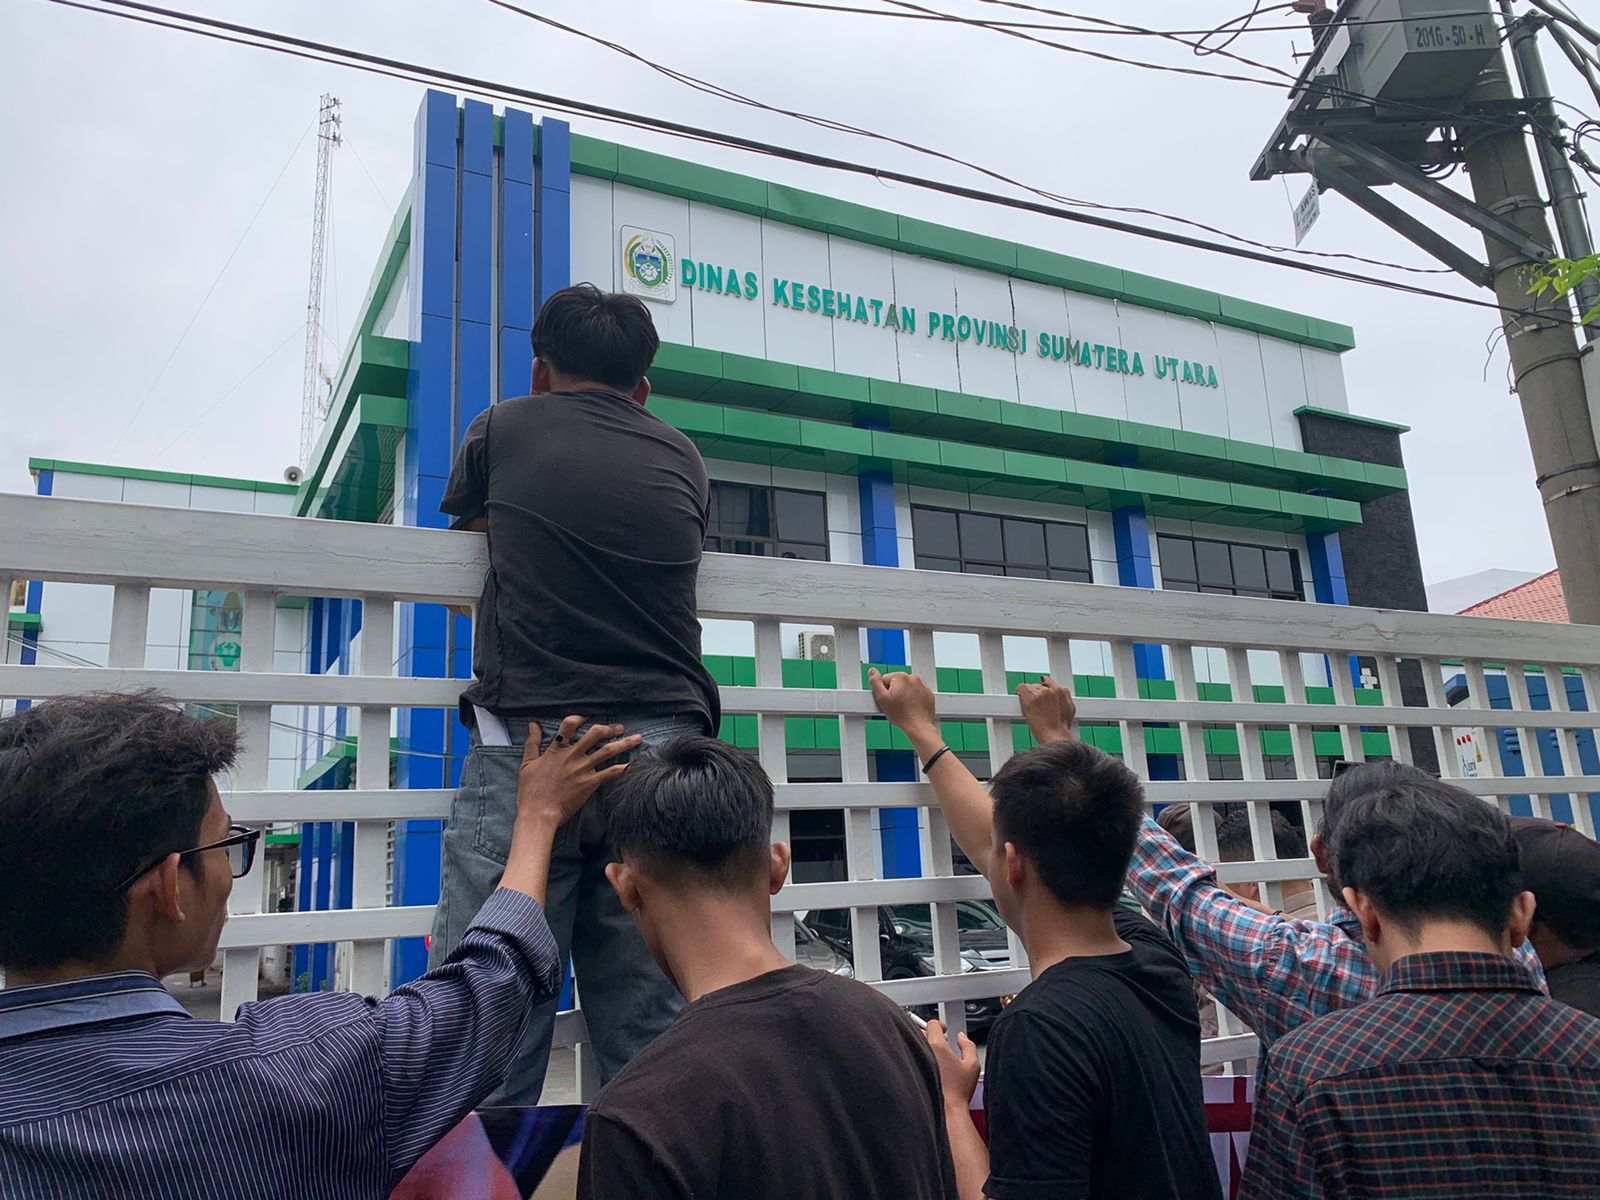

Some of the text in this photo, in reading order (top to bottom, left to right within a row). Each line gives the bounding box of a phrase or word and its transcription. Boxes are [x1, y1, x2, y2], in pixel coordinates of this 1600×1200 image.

[681, 258, 1219, 388] DINAS KESEHATAN PROVINSI SUMATERA UTARA
